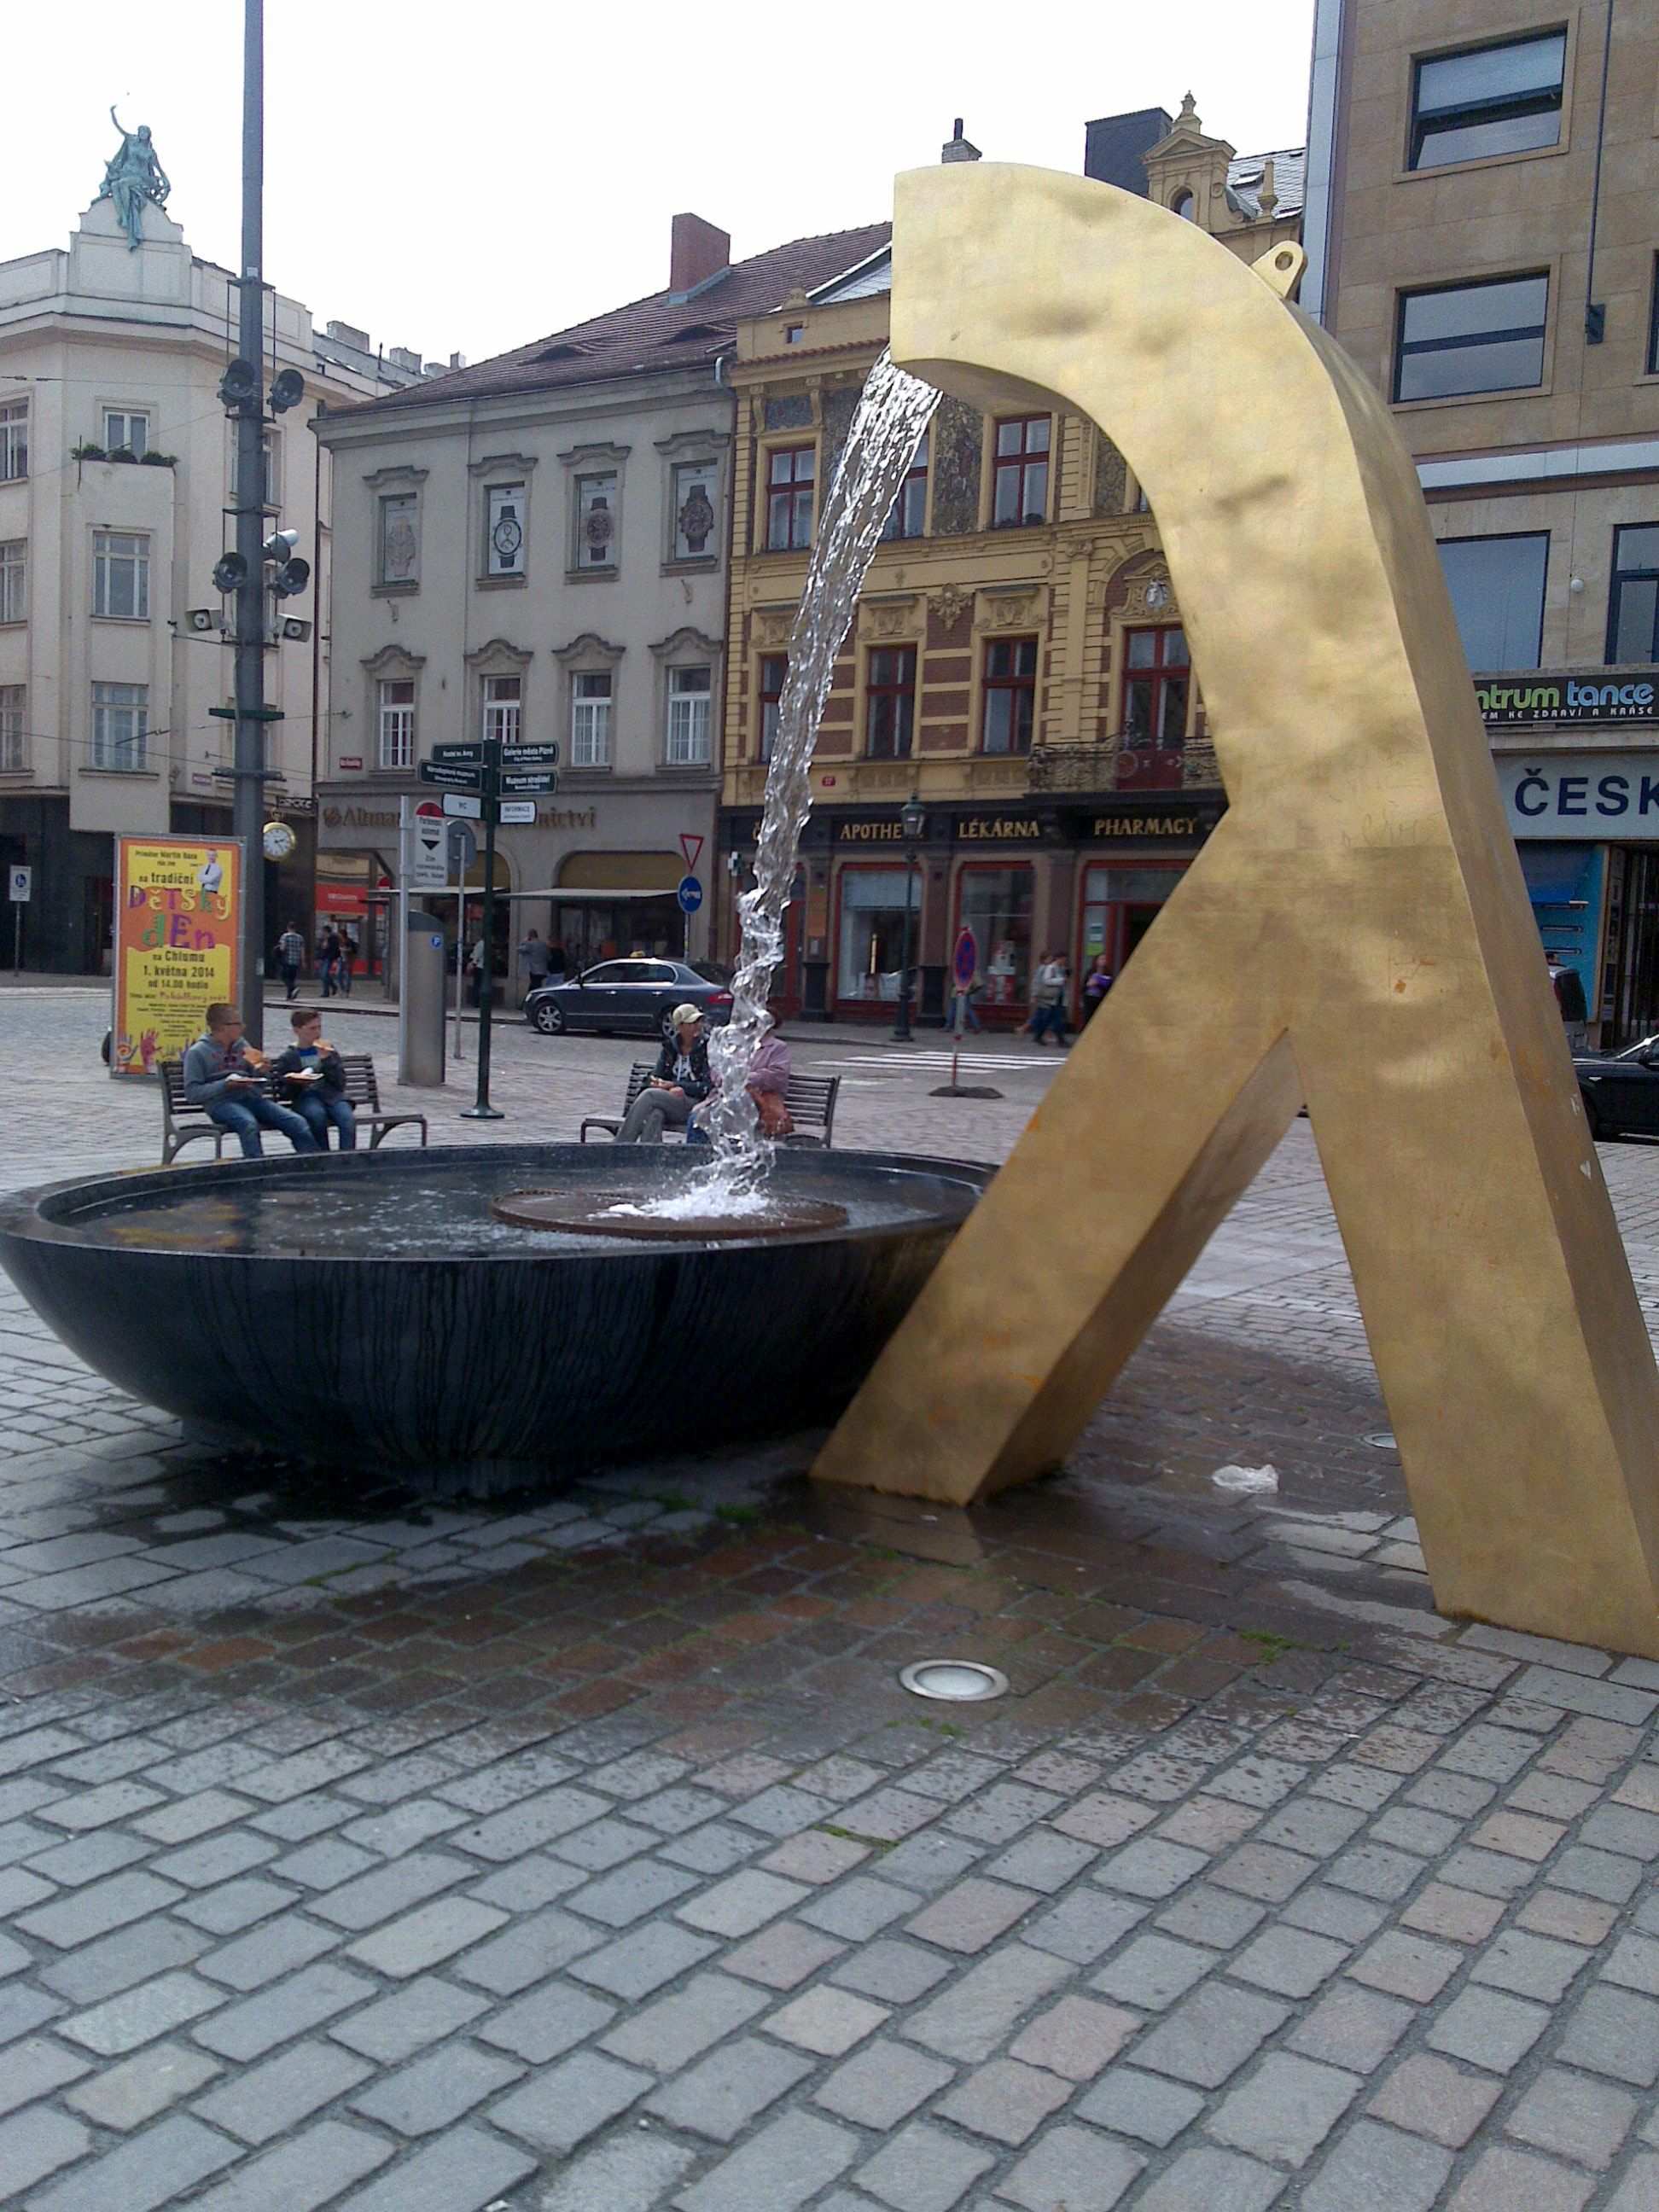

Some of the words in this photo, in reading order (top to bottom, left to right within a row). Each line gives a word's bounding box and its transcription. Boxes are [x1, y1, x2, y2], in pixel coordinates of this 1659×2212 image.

[1567, 681, 1654, 706] tance
[1509, 710, 1523, 719] KE
[1534, 707, 1582, 719] ZDRAVÍ
[1610, 705, 1653, 717] KRÁSE
[841, 824, 924, 839] APOTHE
[959, 818, 1039, 838] LÉKÁRNA
[1094, 818, 1196, 835] PHARMACY
[151, 872, 194, 884] tradiční
[165, 951, 205, 962] Chlumu
[154, 965, 187, 977] května
[191, 967, 215, 977] 2014
[186, 981, 208, 989] hodin
